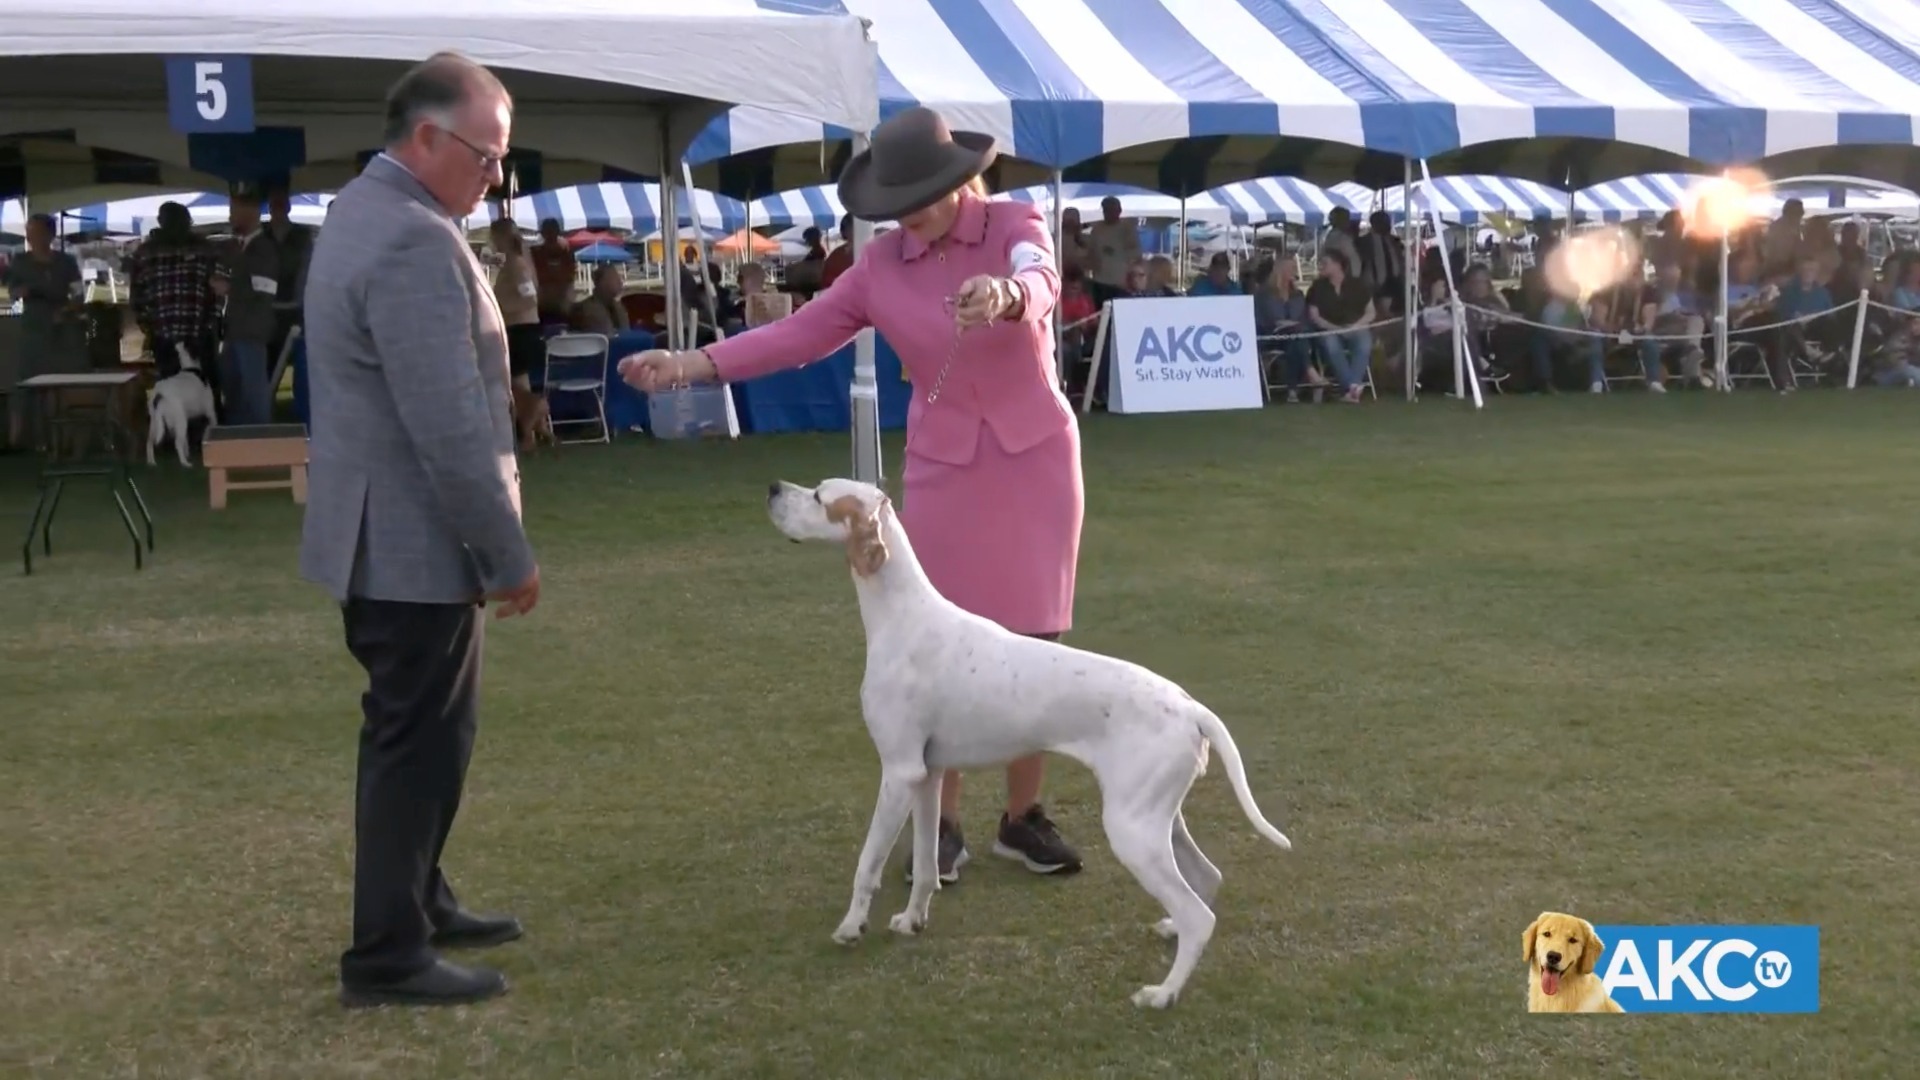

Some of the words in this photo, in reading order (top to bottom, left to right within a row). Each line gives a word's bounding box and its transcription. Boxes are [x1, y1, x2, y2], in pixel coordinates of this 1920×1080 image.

[195, 62, 227, 120] 5
[1134, 325, 1224, 364] AKC
[1135, 367, 1159, 382] Sit.
[1195, 365, 1245, 379] Watch.
